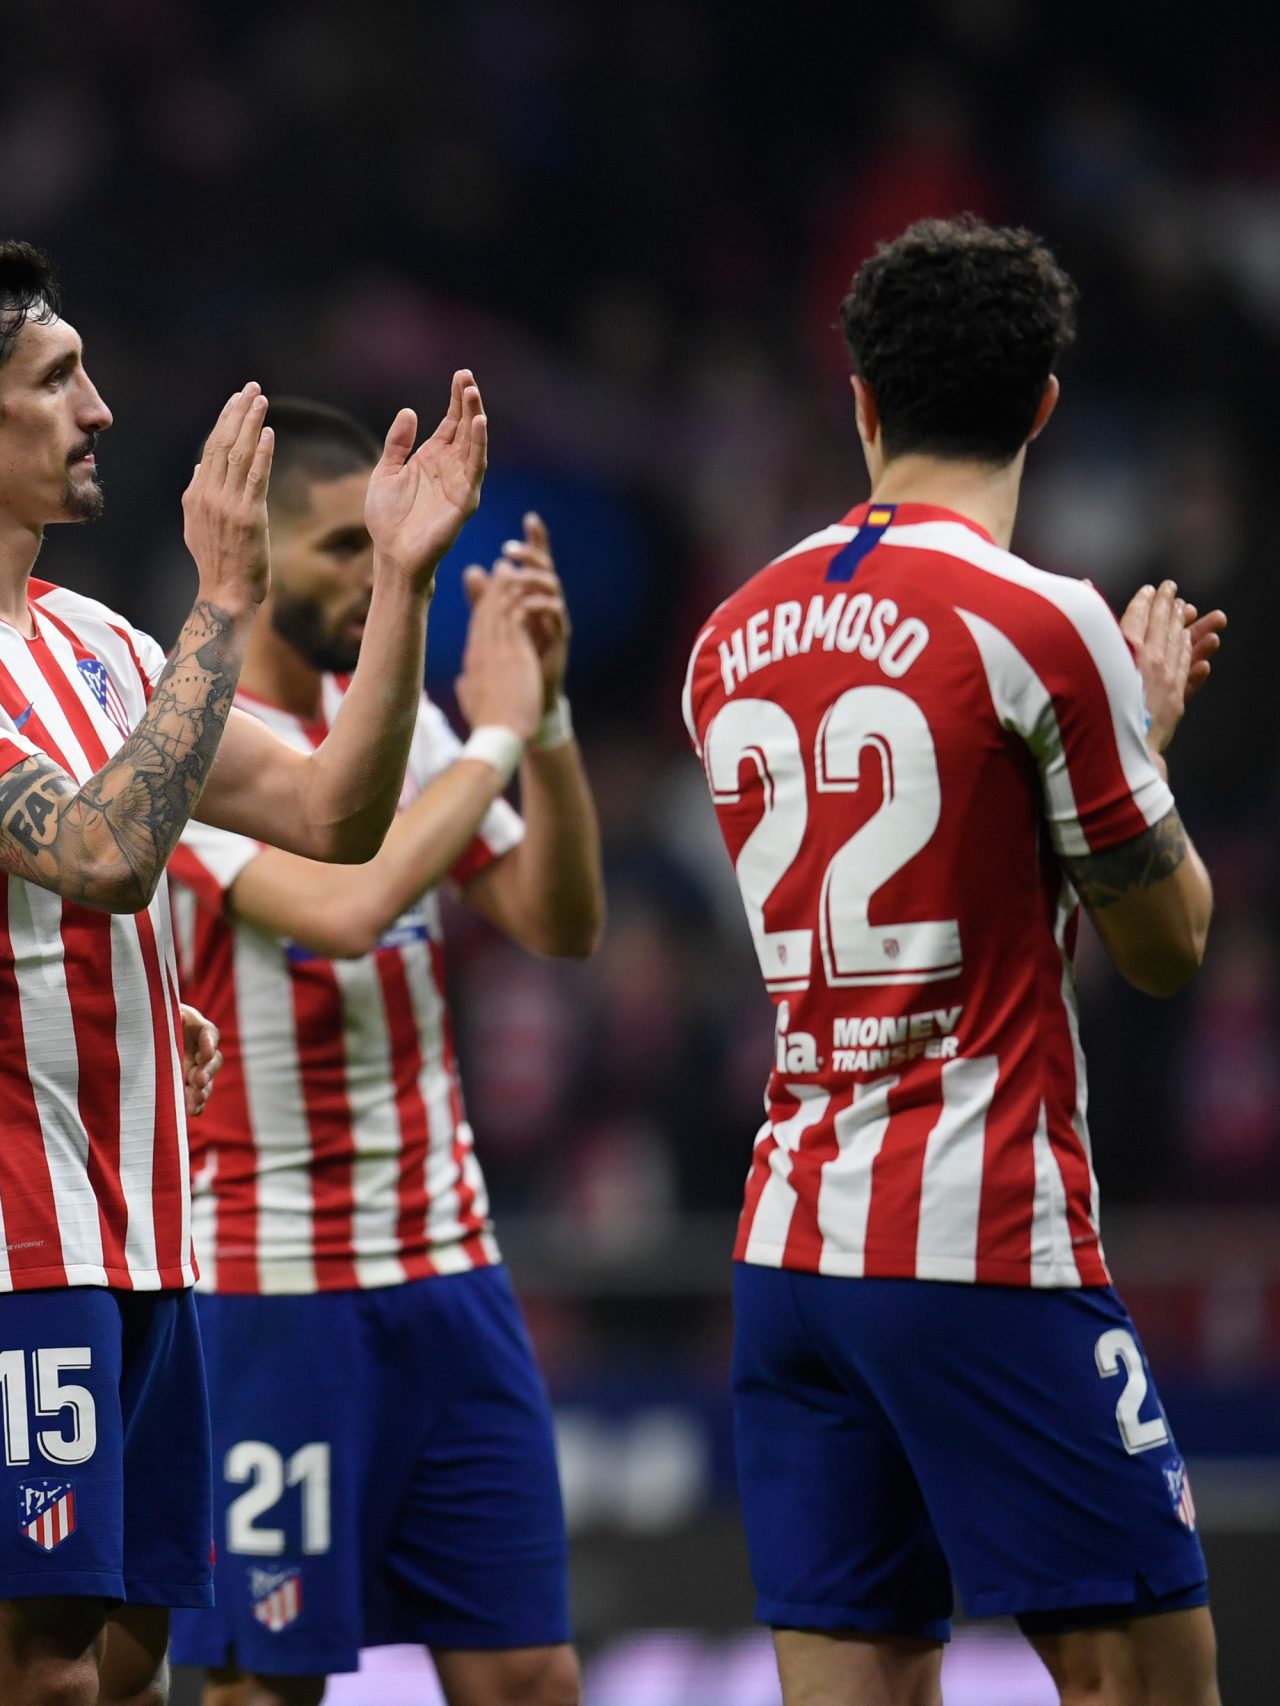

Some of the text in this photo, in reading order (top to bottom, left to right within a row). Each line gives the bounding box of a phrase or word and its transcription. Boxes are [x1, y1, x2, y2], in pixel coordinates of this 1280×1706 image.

[718, 592, 930, 696] HERMOSO
[703, 685, 963, 992] 22
[832, 1036, 960, 1072] TRANSFER
[833, 1006, 964, 1048] MONEY
[1094, 1328, 1169, 1455] 2
[224, 1440, 331, 1556] 21
